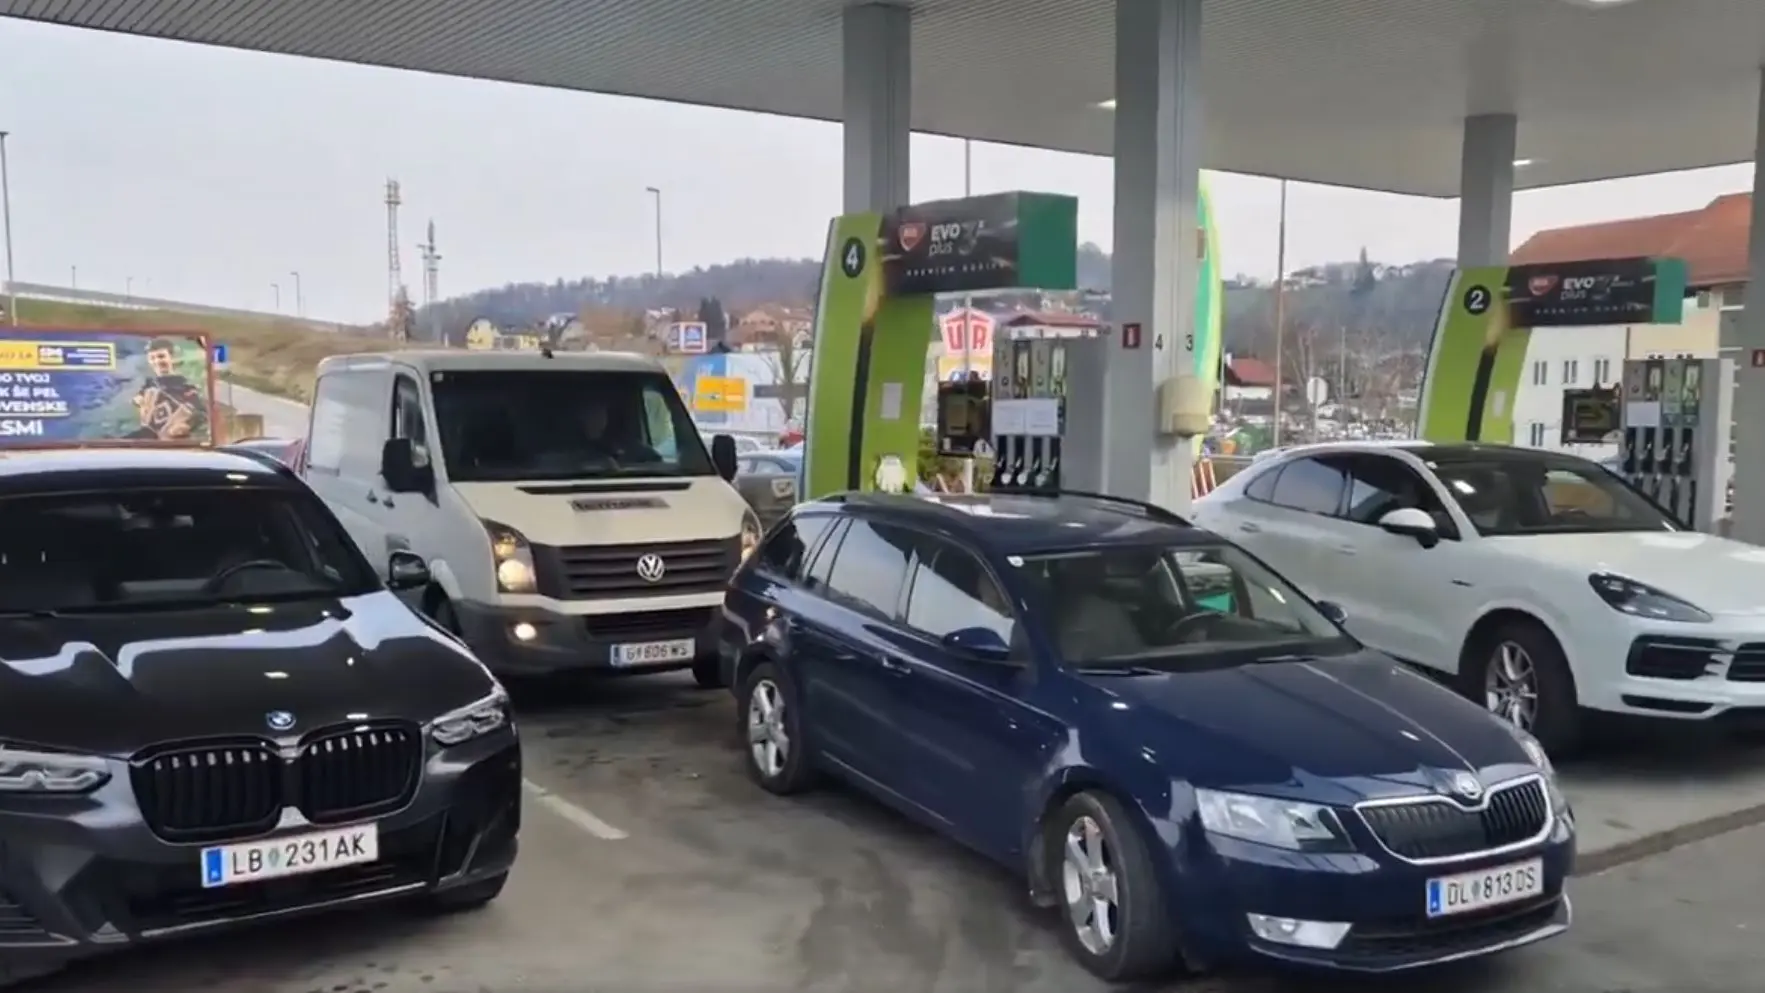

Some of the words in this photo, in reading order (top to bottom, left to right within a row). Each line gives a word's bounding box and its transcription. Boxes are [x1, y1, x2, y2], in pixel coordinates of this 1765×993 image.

[931, 223, 960, 241] EVO
[845, 244, 859, 270] 4
[928, 240, 953, 257] plus
[1563, 276, 1596, 290] EVO
[1470, 289, 1485, 309] 2
[1155, 333, 1163, 350] 4
[1185, 334, 1193, 351] 3
[15, 372, 50, 383] TVOJ
[33, 387, 60, 398] PEL
[0, 419, 43, 436] SMI
[232, 848, 263, 875] LB
[1447, 882, 1468, 906] DL
